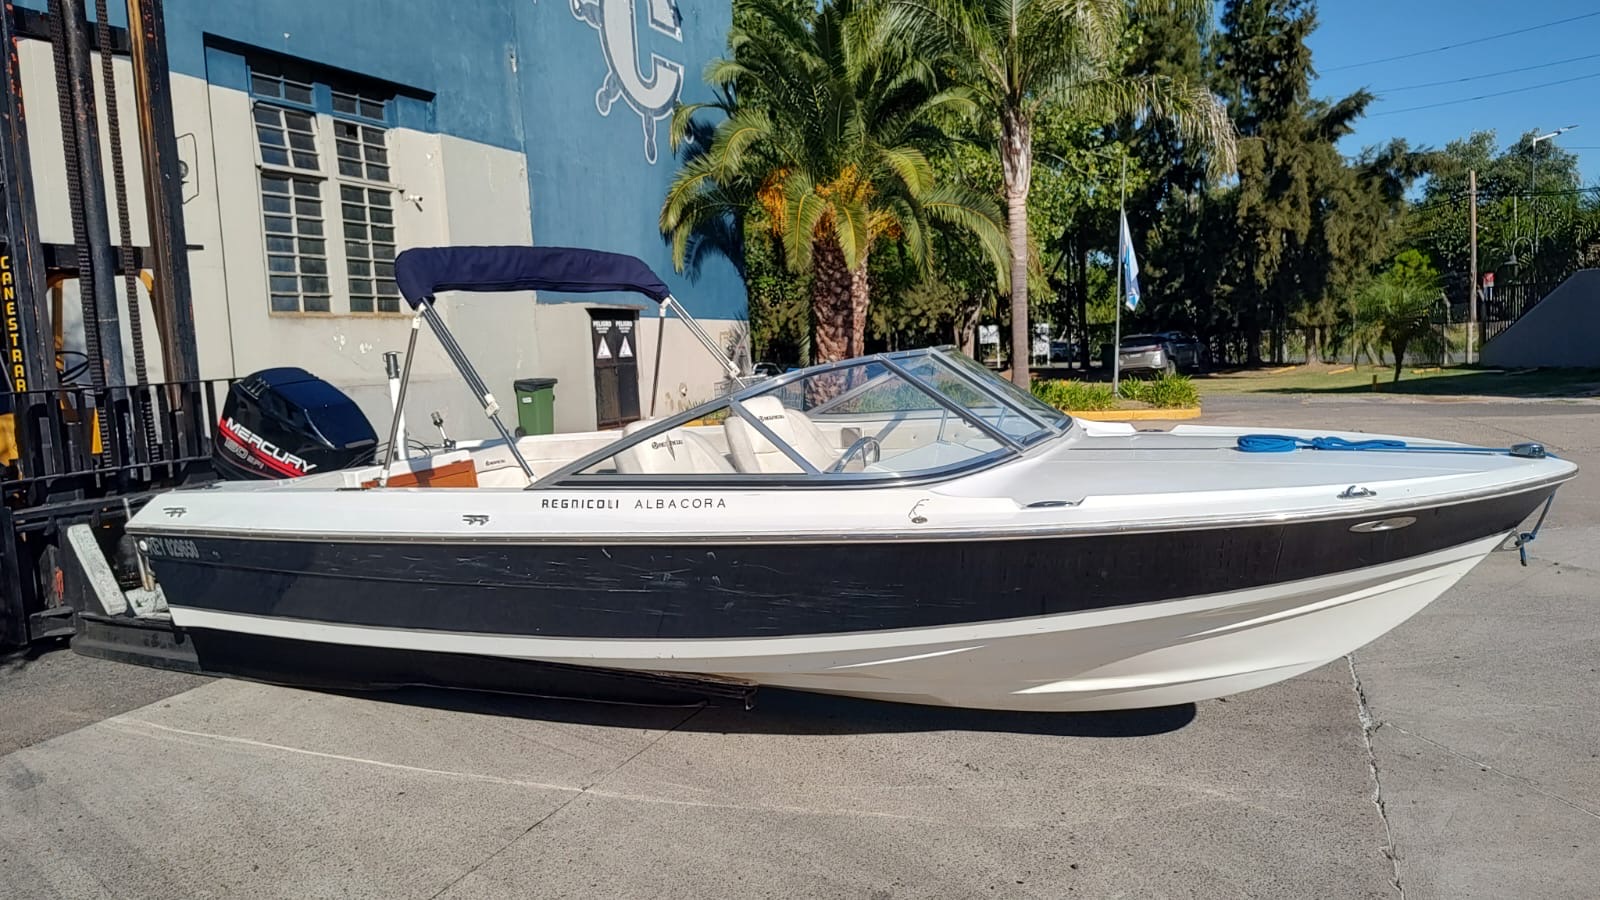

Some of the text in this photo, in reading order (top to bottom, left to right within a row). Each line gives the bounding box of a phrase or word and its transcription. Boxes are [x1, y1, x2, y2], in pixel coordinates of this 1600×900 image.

[592, 320, 612, 328] PELIGRO
[615, 320, 633, 328] PELIGRO
[226, 417, 317, 472] MERCURY
[541, 498, 726, 509] REGNICOLI ALBACORA
